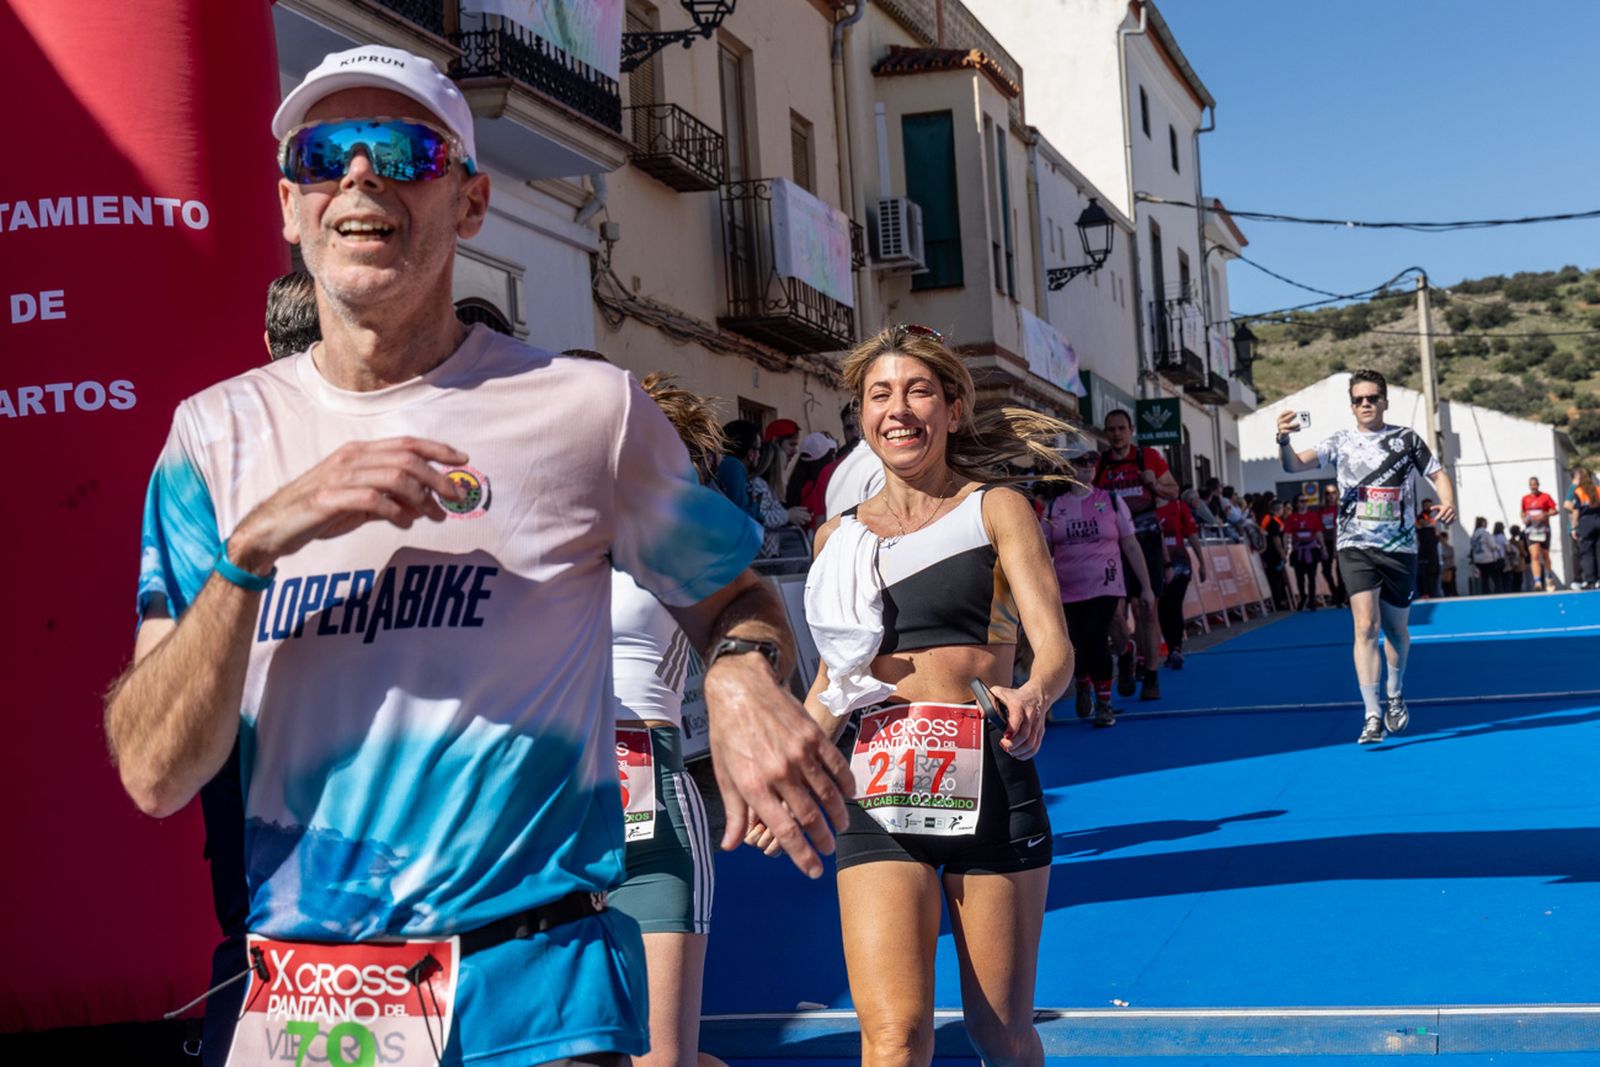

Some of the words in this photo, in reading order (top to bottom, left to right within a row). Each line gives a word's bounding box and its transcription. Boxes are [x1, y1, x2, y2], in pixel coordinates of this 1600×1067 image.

[340, 55, 405, 68] KIPRUN
[9, 289, 67, 325] DE
[1365, 501, 1393, 516] 818
[257, 564, 499, 644] LOPERABIKE
[871, 715, 889, 738] X
[890, 717, 959, 737] CROSS
[868, 736, 941, 753] PANTANO
[866, 748, 956, 796] 217
[270, 949, 295, 992] X
[295, 962, 411, 997] CROSS
[266, 994, 380, 1025] PANTANO
[384, 1003, 409, 1018] DEL
